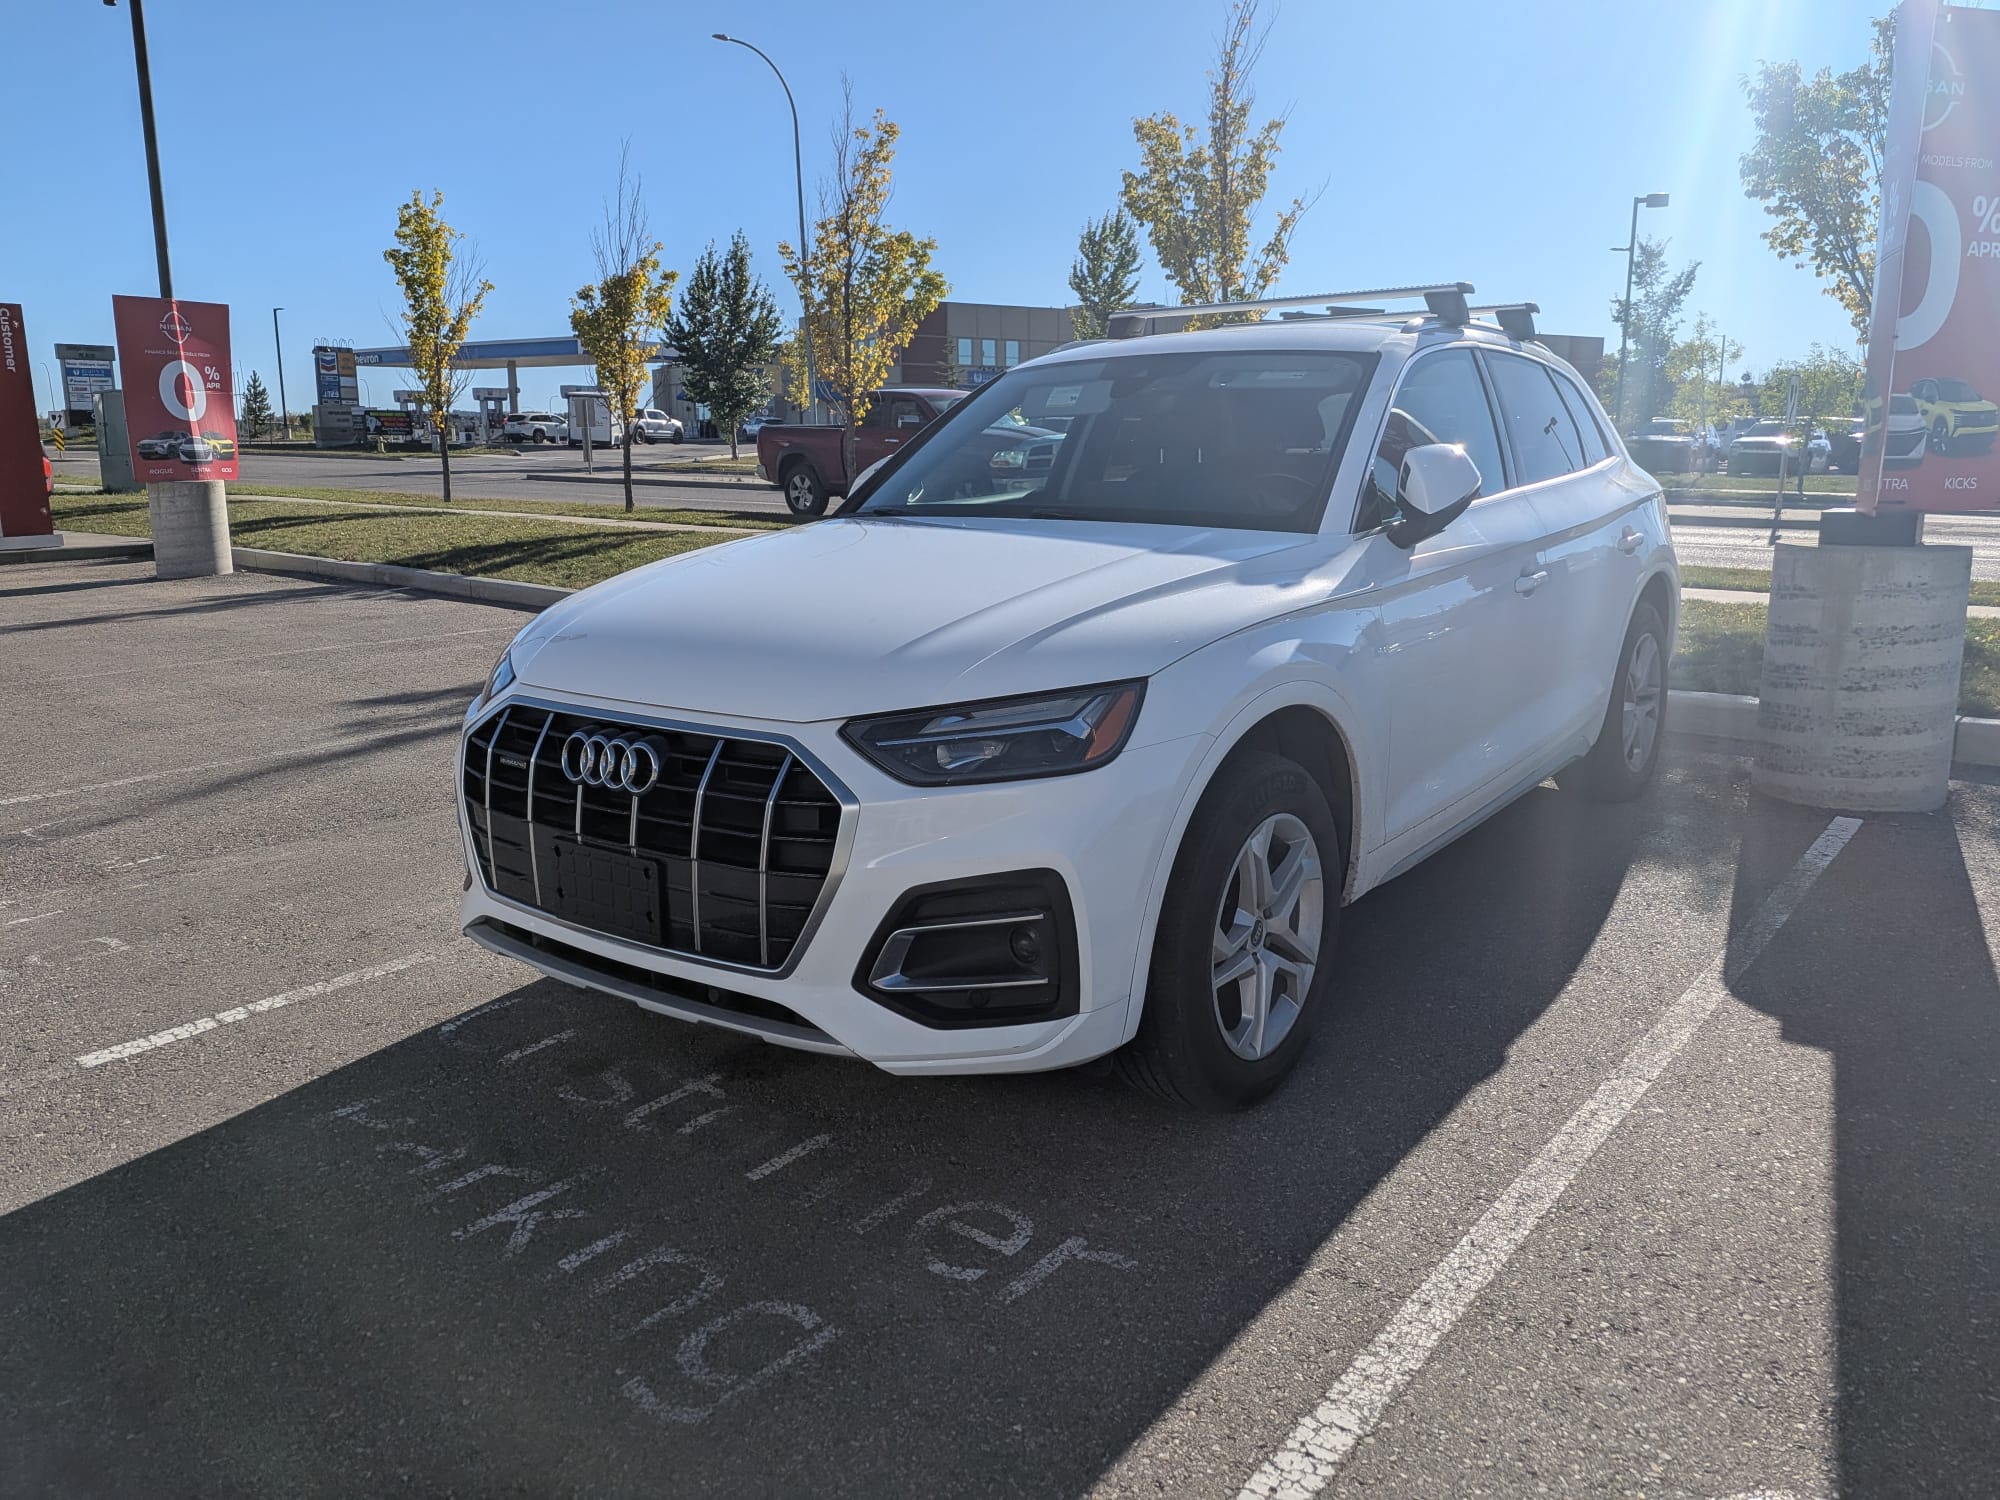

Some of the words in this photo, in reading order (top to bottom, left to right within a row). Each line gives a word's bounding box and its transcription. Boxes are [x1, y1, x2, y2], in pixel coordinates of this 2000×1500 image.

[1926, 80, 1965, 97] SAN
[1920, 154, 1963, 168] MODELS
[1966, 158, 1993, 169] FROM
[1967, 240, 2000, 258] APR
[0, 307, 16, 373] Customer
[355, 354, 379, 364] hevron
[159, 360, 207, 422] 0
[1880, 478, 1909, 490] TRA
[1944, 477, 1977, 490] KICKS
